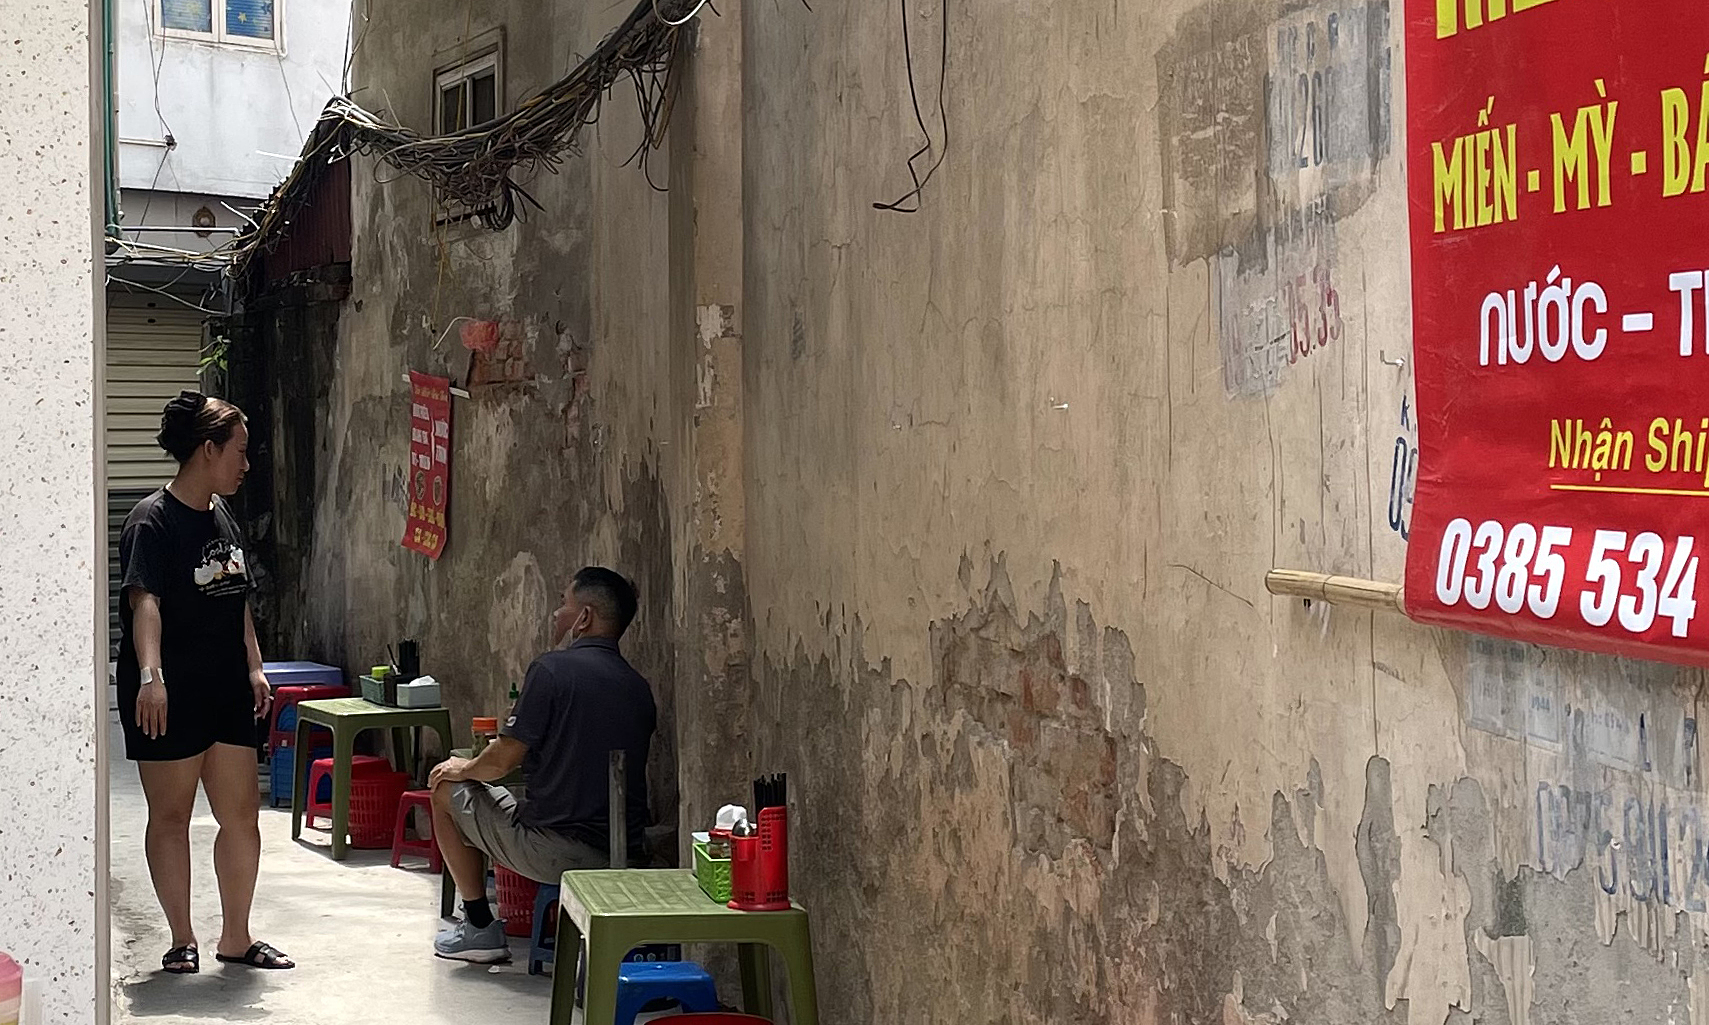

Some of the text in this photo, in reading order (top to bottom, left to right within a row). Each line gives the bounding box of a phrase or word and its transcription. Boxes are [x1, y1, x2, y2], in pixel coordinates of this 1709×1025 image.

[1431, 95, 1518, 233] MIẾN
[1550, 79, 1619, 214] MỲ
[1669, 269, 1709, 356] T
[1549, 417, 1634, 482] Nhận
[1435, 517, 1699, 638] 0385 534
